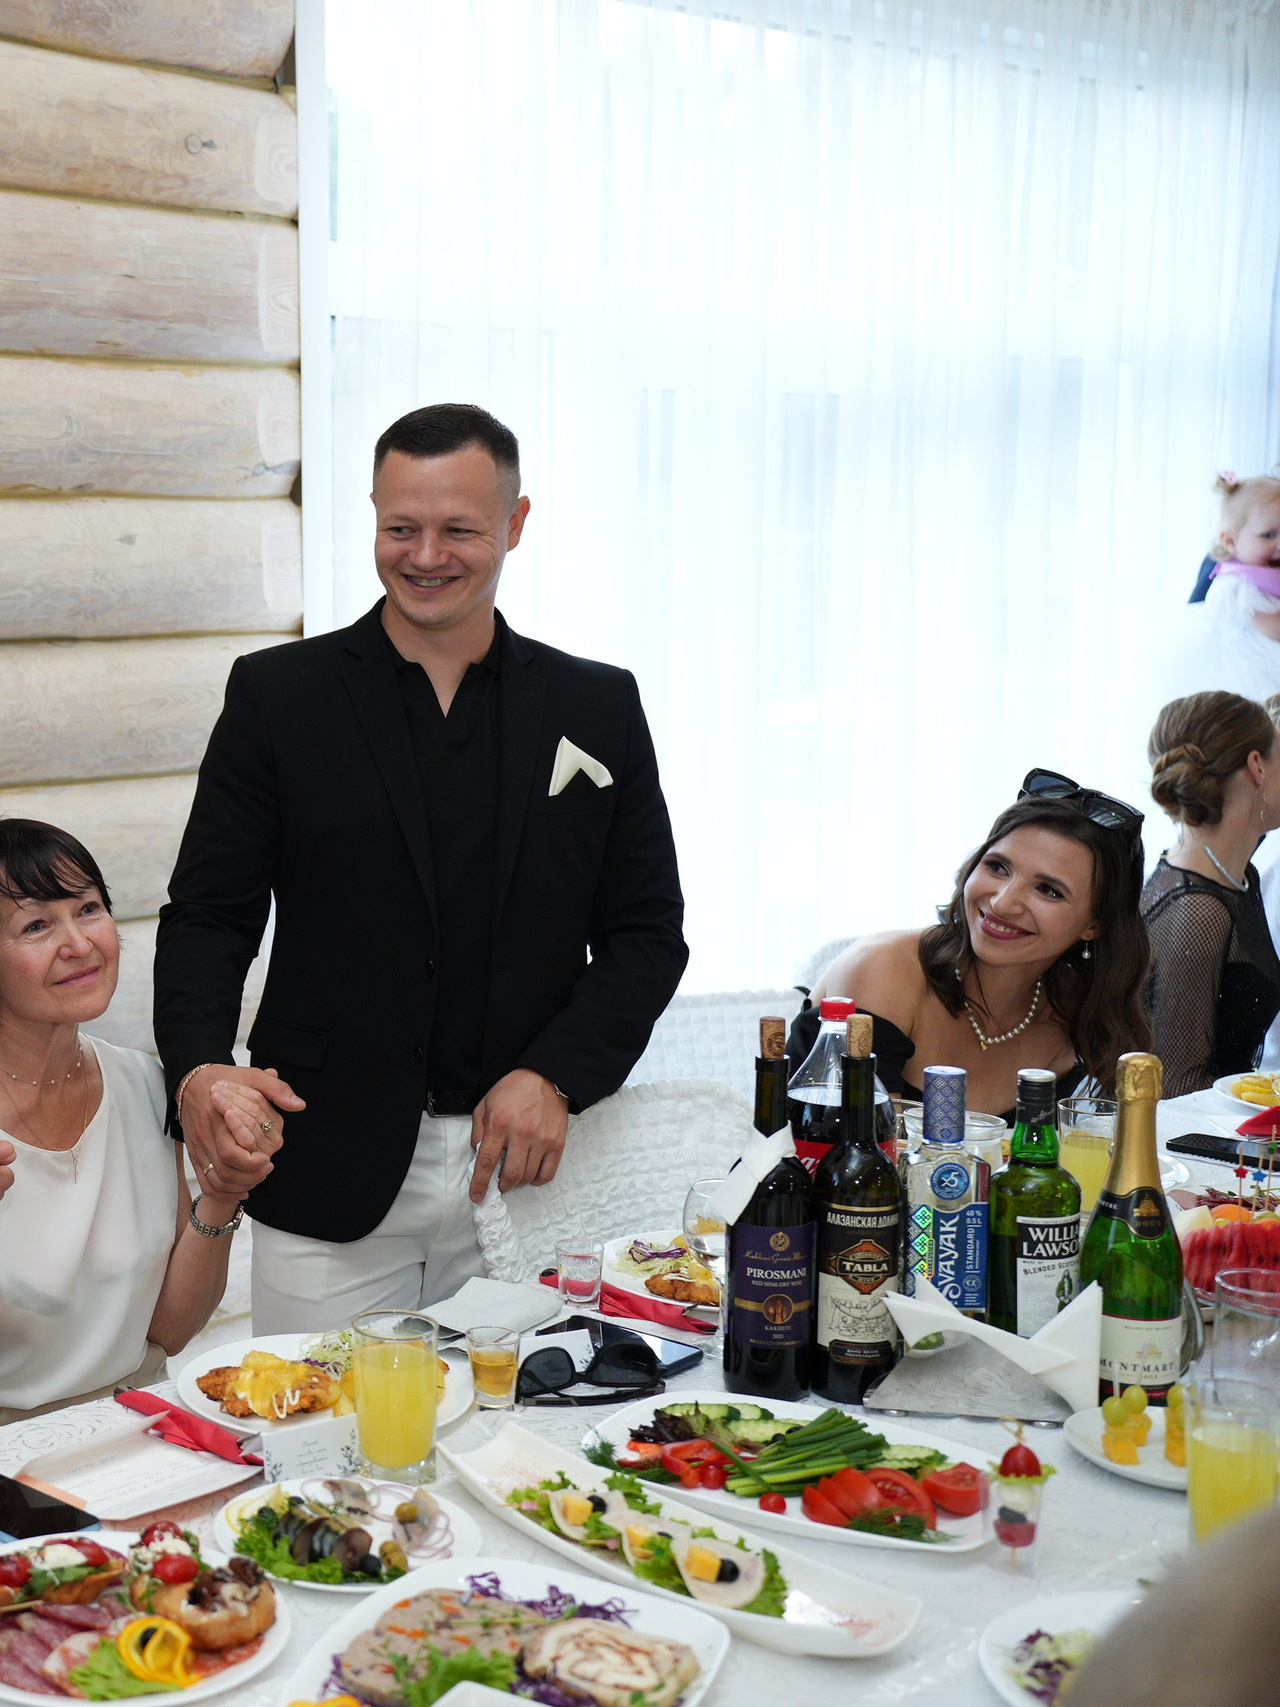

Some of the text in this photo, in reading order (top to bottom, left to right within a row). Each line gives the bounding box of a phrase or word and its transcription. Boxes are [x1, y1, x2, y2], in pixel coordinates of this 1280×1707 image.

[826, 1211, 899, 1228] АЛАЗАНСКАЯ ДОЛИН
[1028, 1224, 1079, 1241] WILLIA
[966, 1228, 975, 1270] STANDARD
[1022, 1239, 1079, 1257] LAWSO
[937, 1214, 962, 1300] SVAYAK
[746, 1267, 806, 1280] PIROSMANI
[842, 1261, 888, 1273] TABLA
[1023, 1264, 1056, 1276] BLENDED
